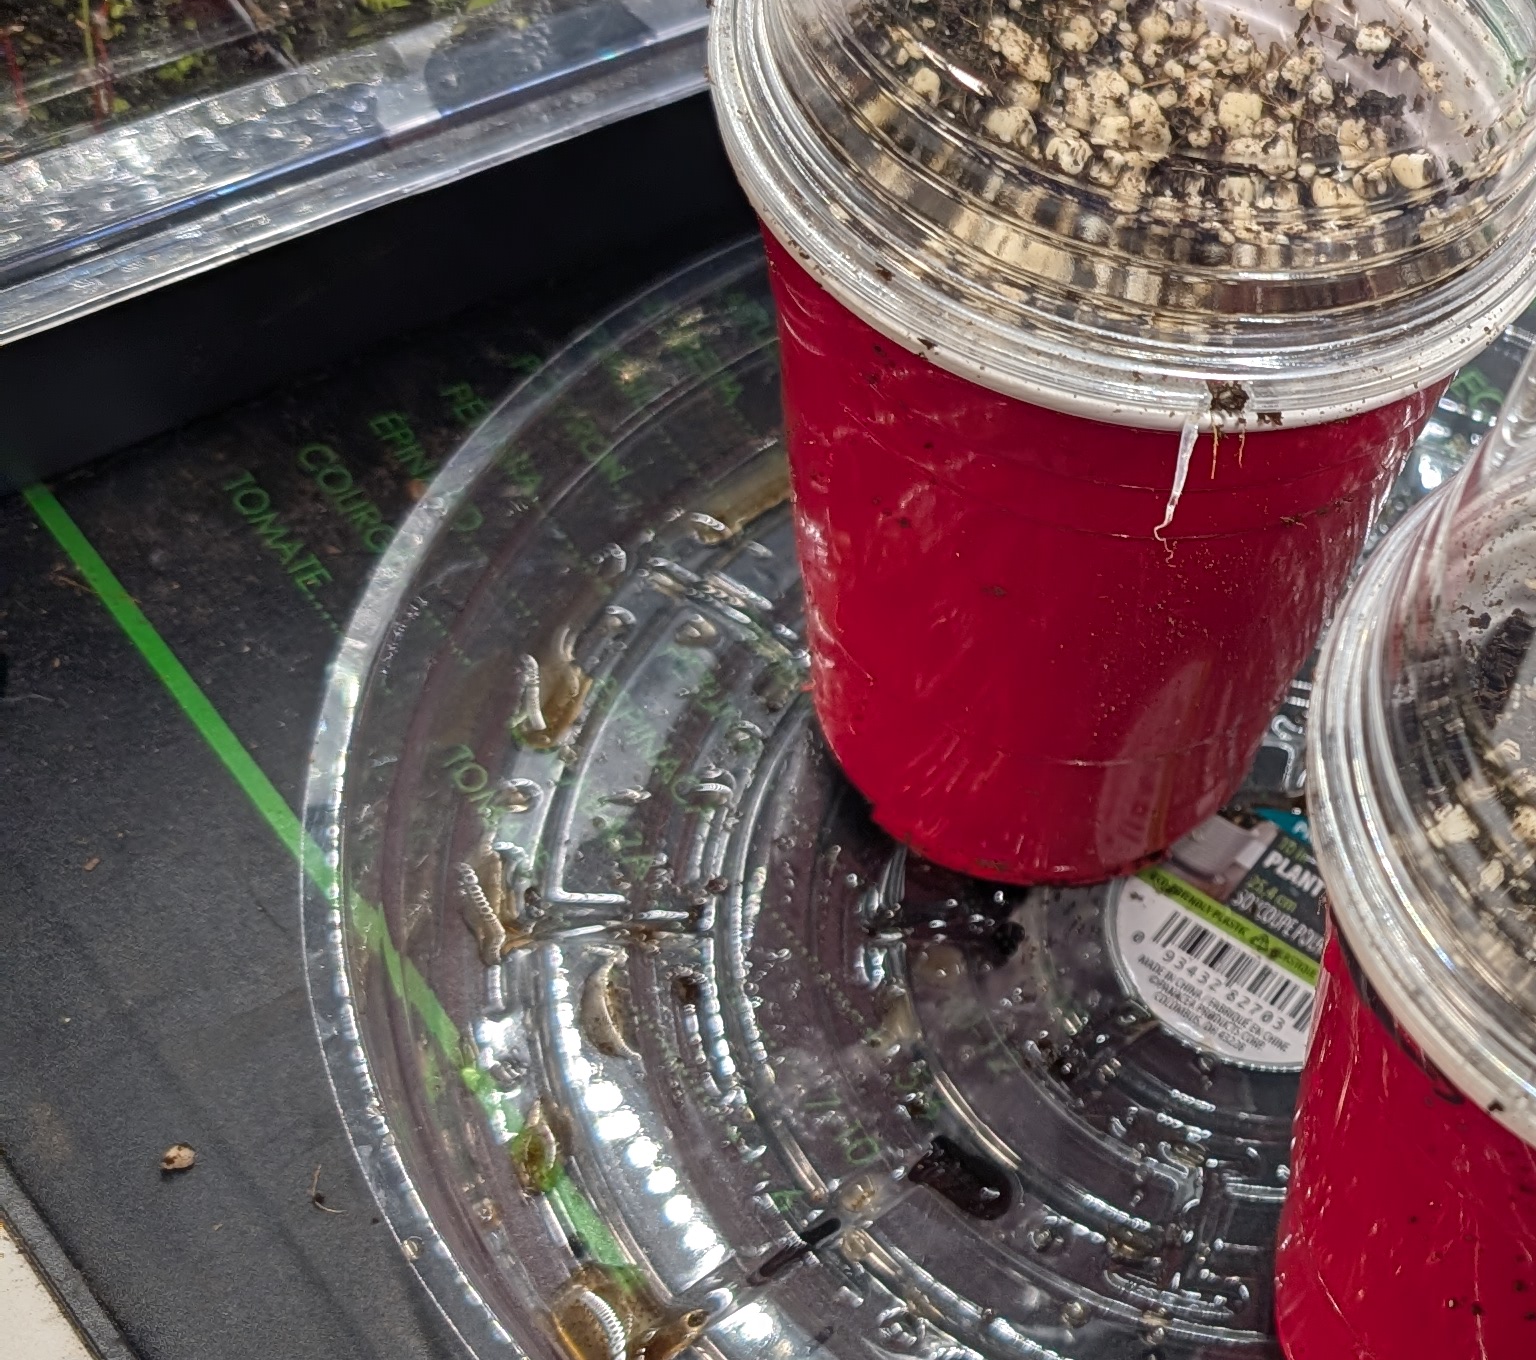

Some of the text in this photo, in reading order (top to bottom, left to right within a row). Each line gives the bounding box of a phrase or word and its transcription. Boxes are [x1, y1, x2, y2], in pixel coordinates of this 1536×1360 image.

[1261, 849, 1327, 899] PLANT
[1272, 890, 1299, 913] cm
[1136, 954, 1166, 977] MADE
[1163, 971, 1176, 983] IN
[1173, 977, 1203, 1000] CHINA
[1248, 1022, 1263, 1036] EN
[1160, 947, 1222, 993] 93432
[1224, 987, 1287, 1032] 82703
